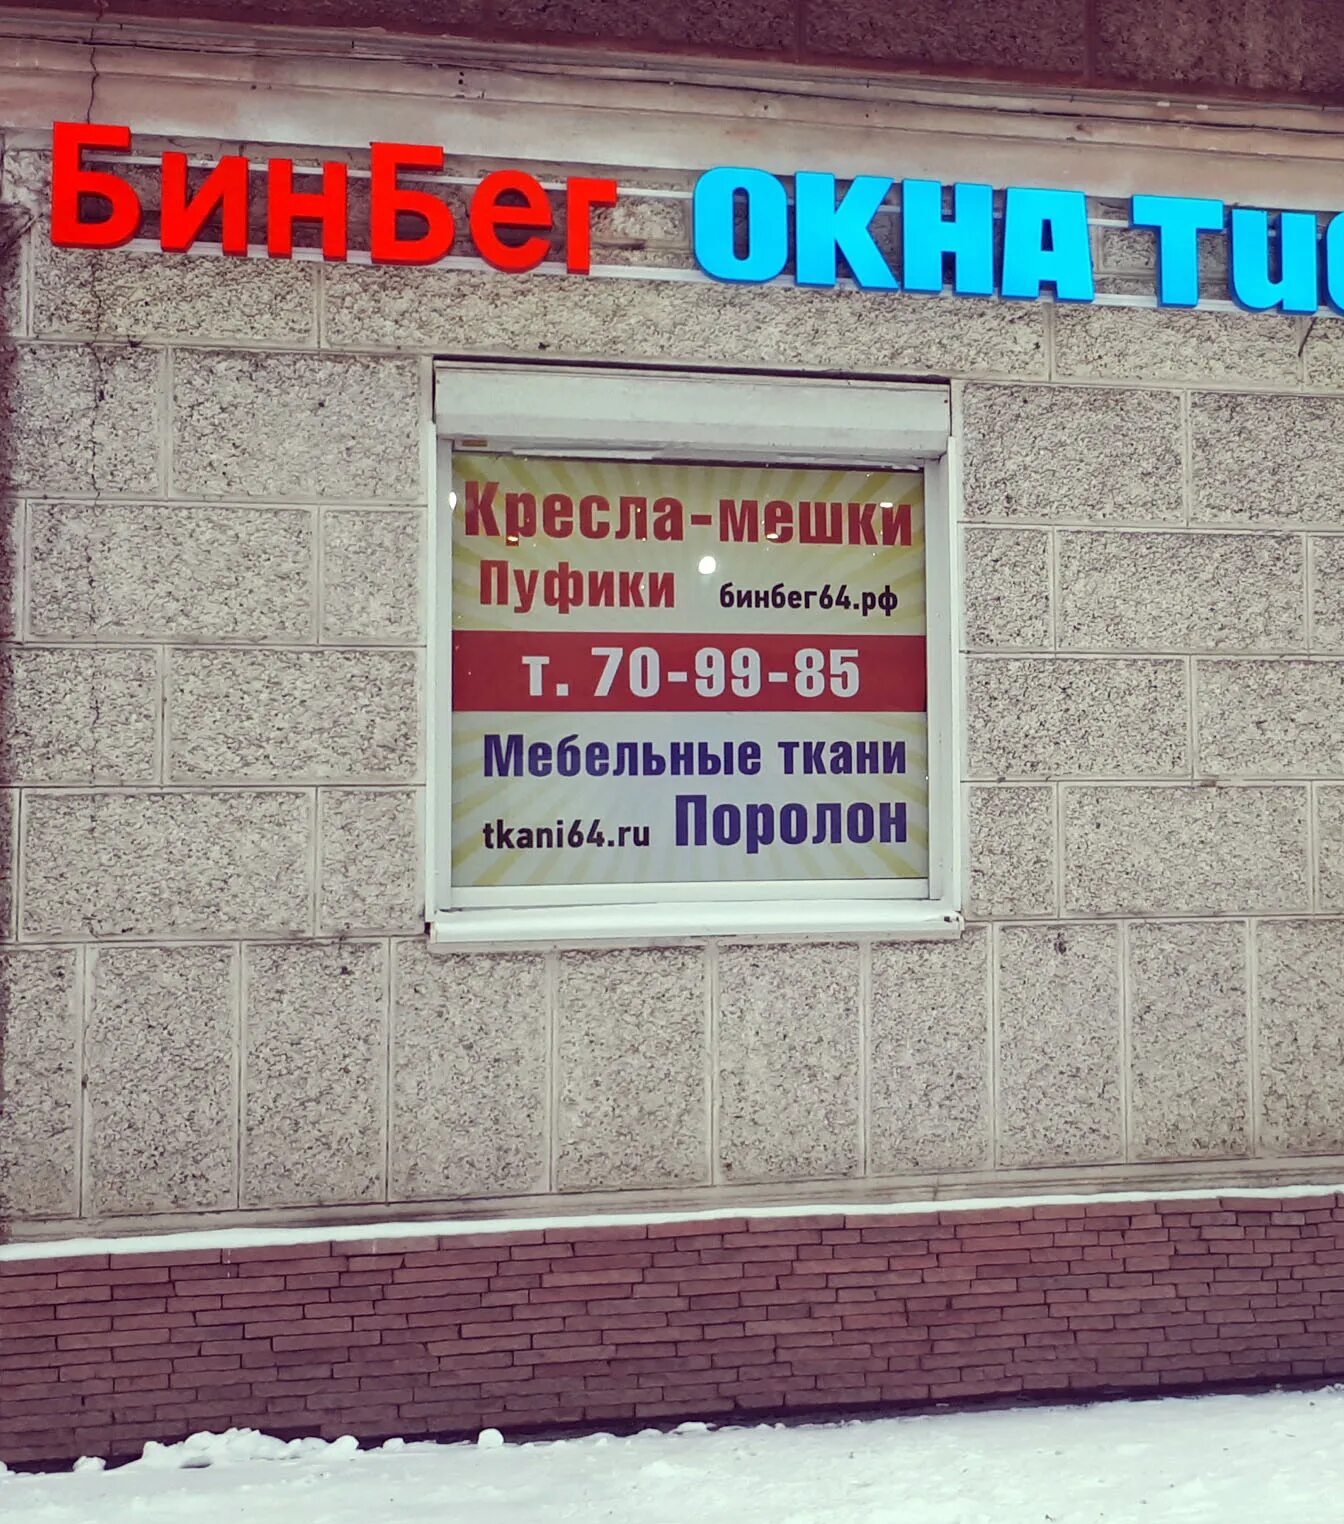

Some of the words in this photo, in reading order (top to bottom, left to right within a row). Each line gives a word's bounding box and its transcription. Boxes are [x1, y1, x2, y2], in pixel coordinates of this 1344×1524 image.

[51, 121, 617, 274] БинБег
[692, 166, 1095, 303] ОКНА
[464, 480, 912, 546] Кресла-мешки
[479, 559, 676, 614] Пуфики
[719, 582, 898, 616] бинбег64.рф
[521, 655, 569, 697] т.
[591, 646, 861, 698] 70-99-85
[482, 734, 761, 777] Мебельные
[777, 740, 907, 775] ткани
[482, 819, 650, 849] tkani64.ru
[675, 794, 907, 853] Поролон
